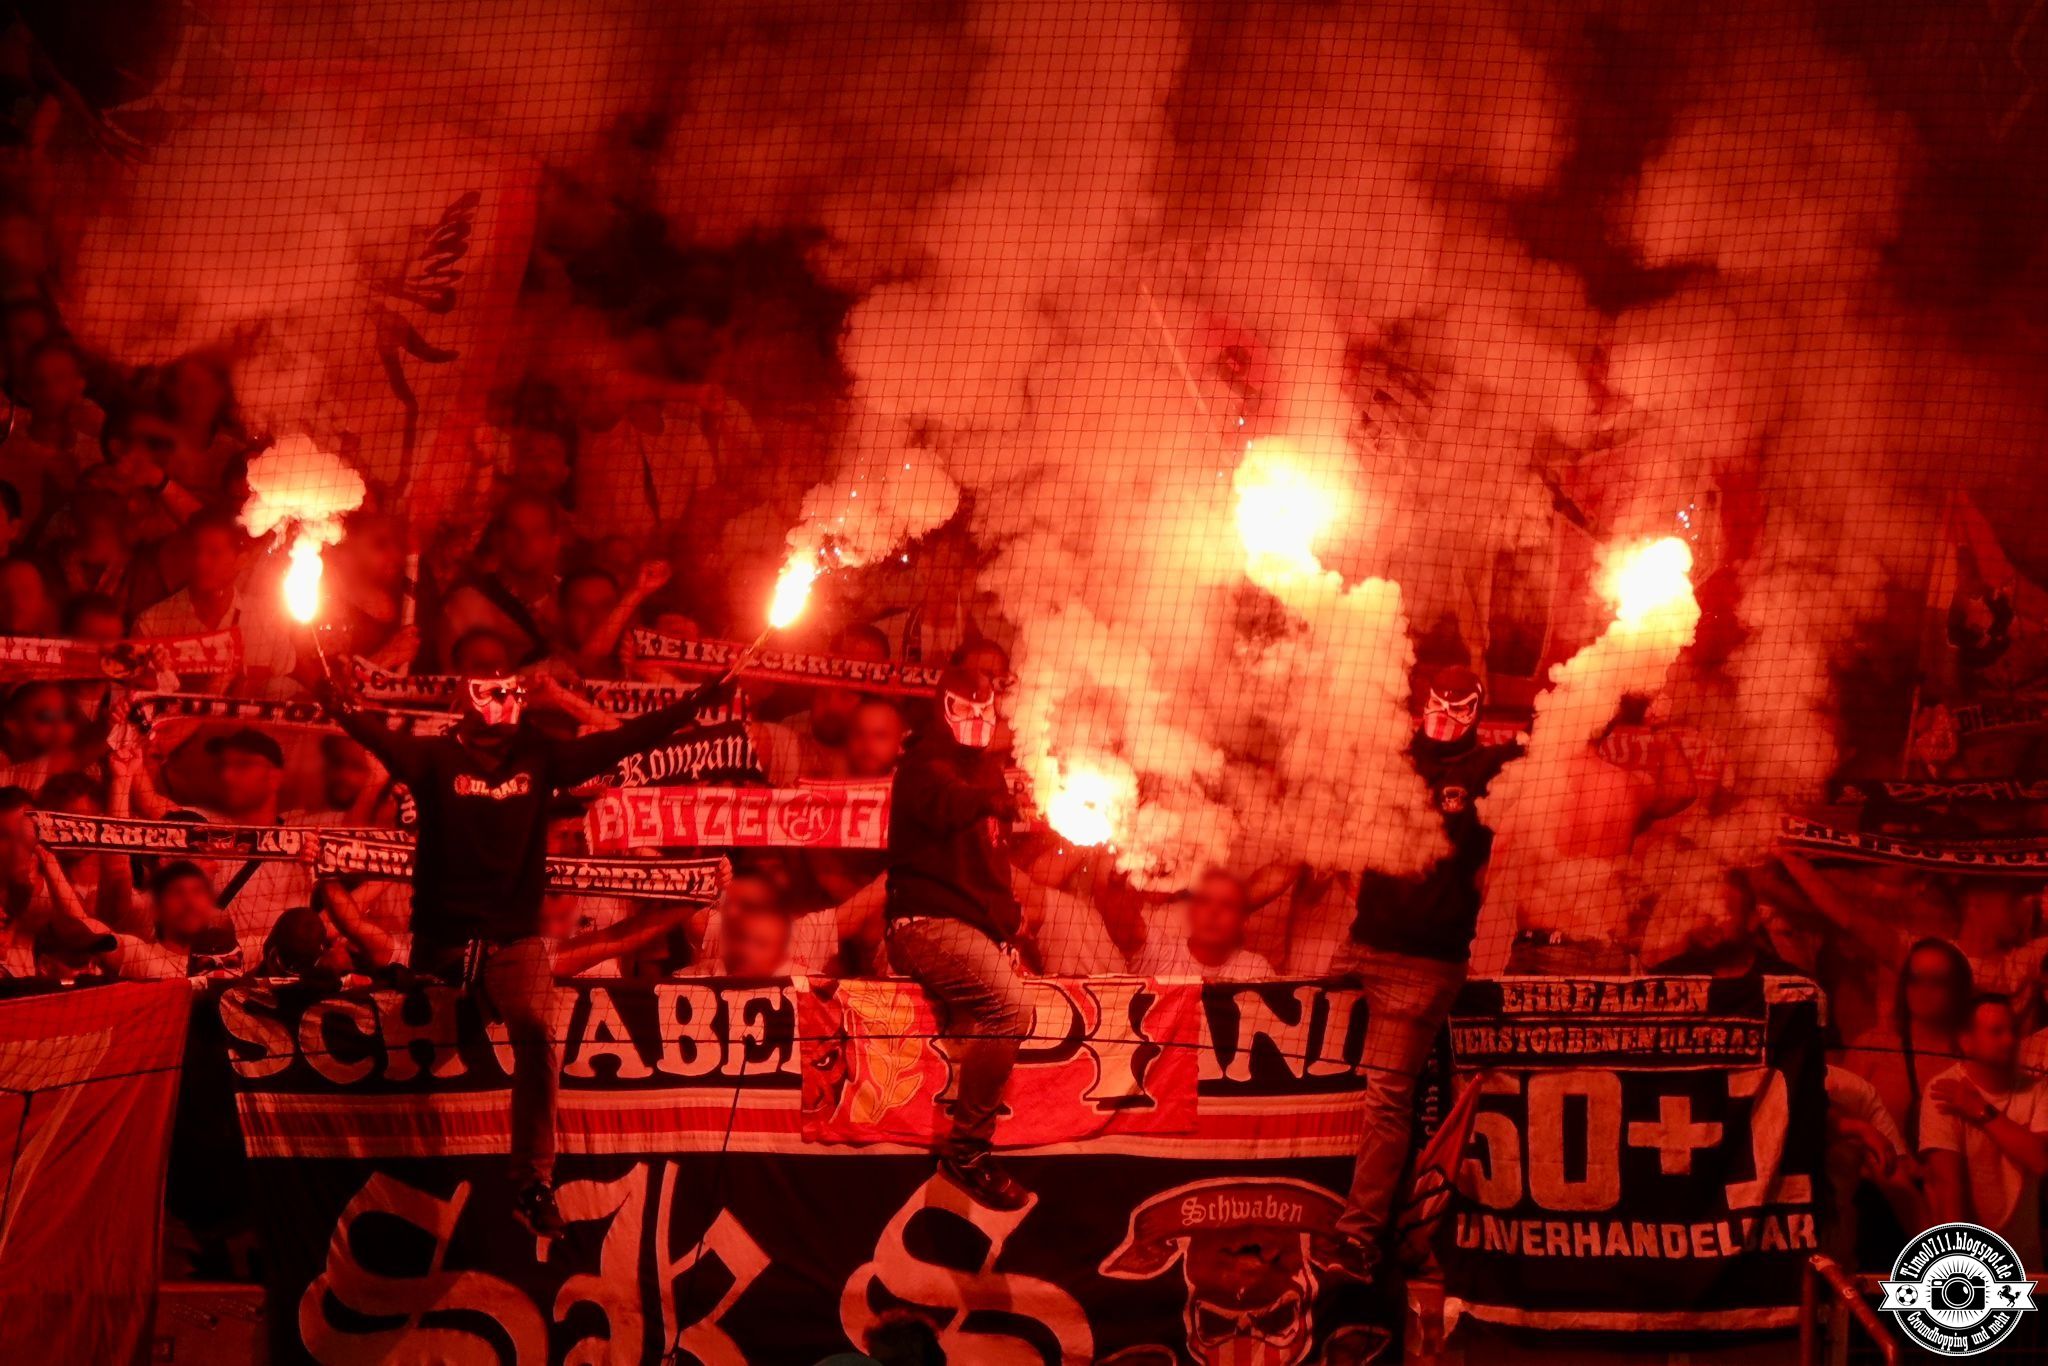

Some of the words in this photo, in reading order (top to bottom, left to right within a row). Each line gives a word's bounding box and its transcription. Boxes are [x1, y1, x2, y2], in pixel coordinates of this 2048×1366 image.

[598, 794, 766, 842] BETZE
[1501, 981, 1596, 1013] EHRE
[1599, 980, 1709, 1013] ALLEN
[1181, 1194, 1303, 1227] Schwaben
